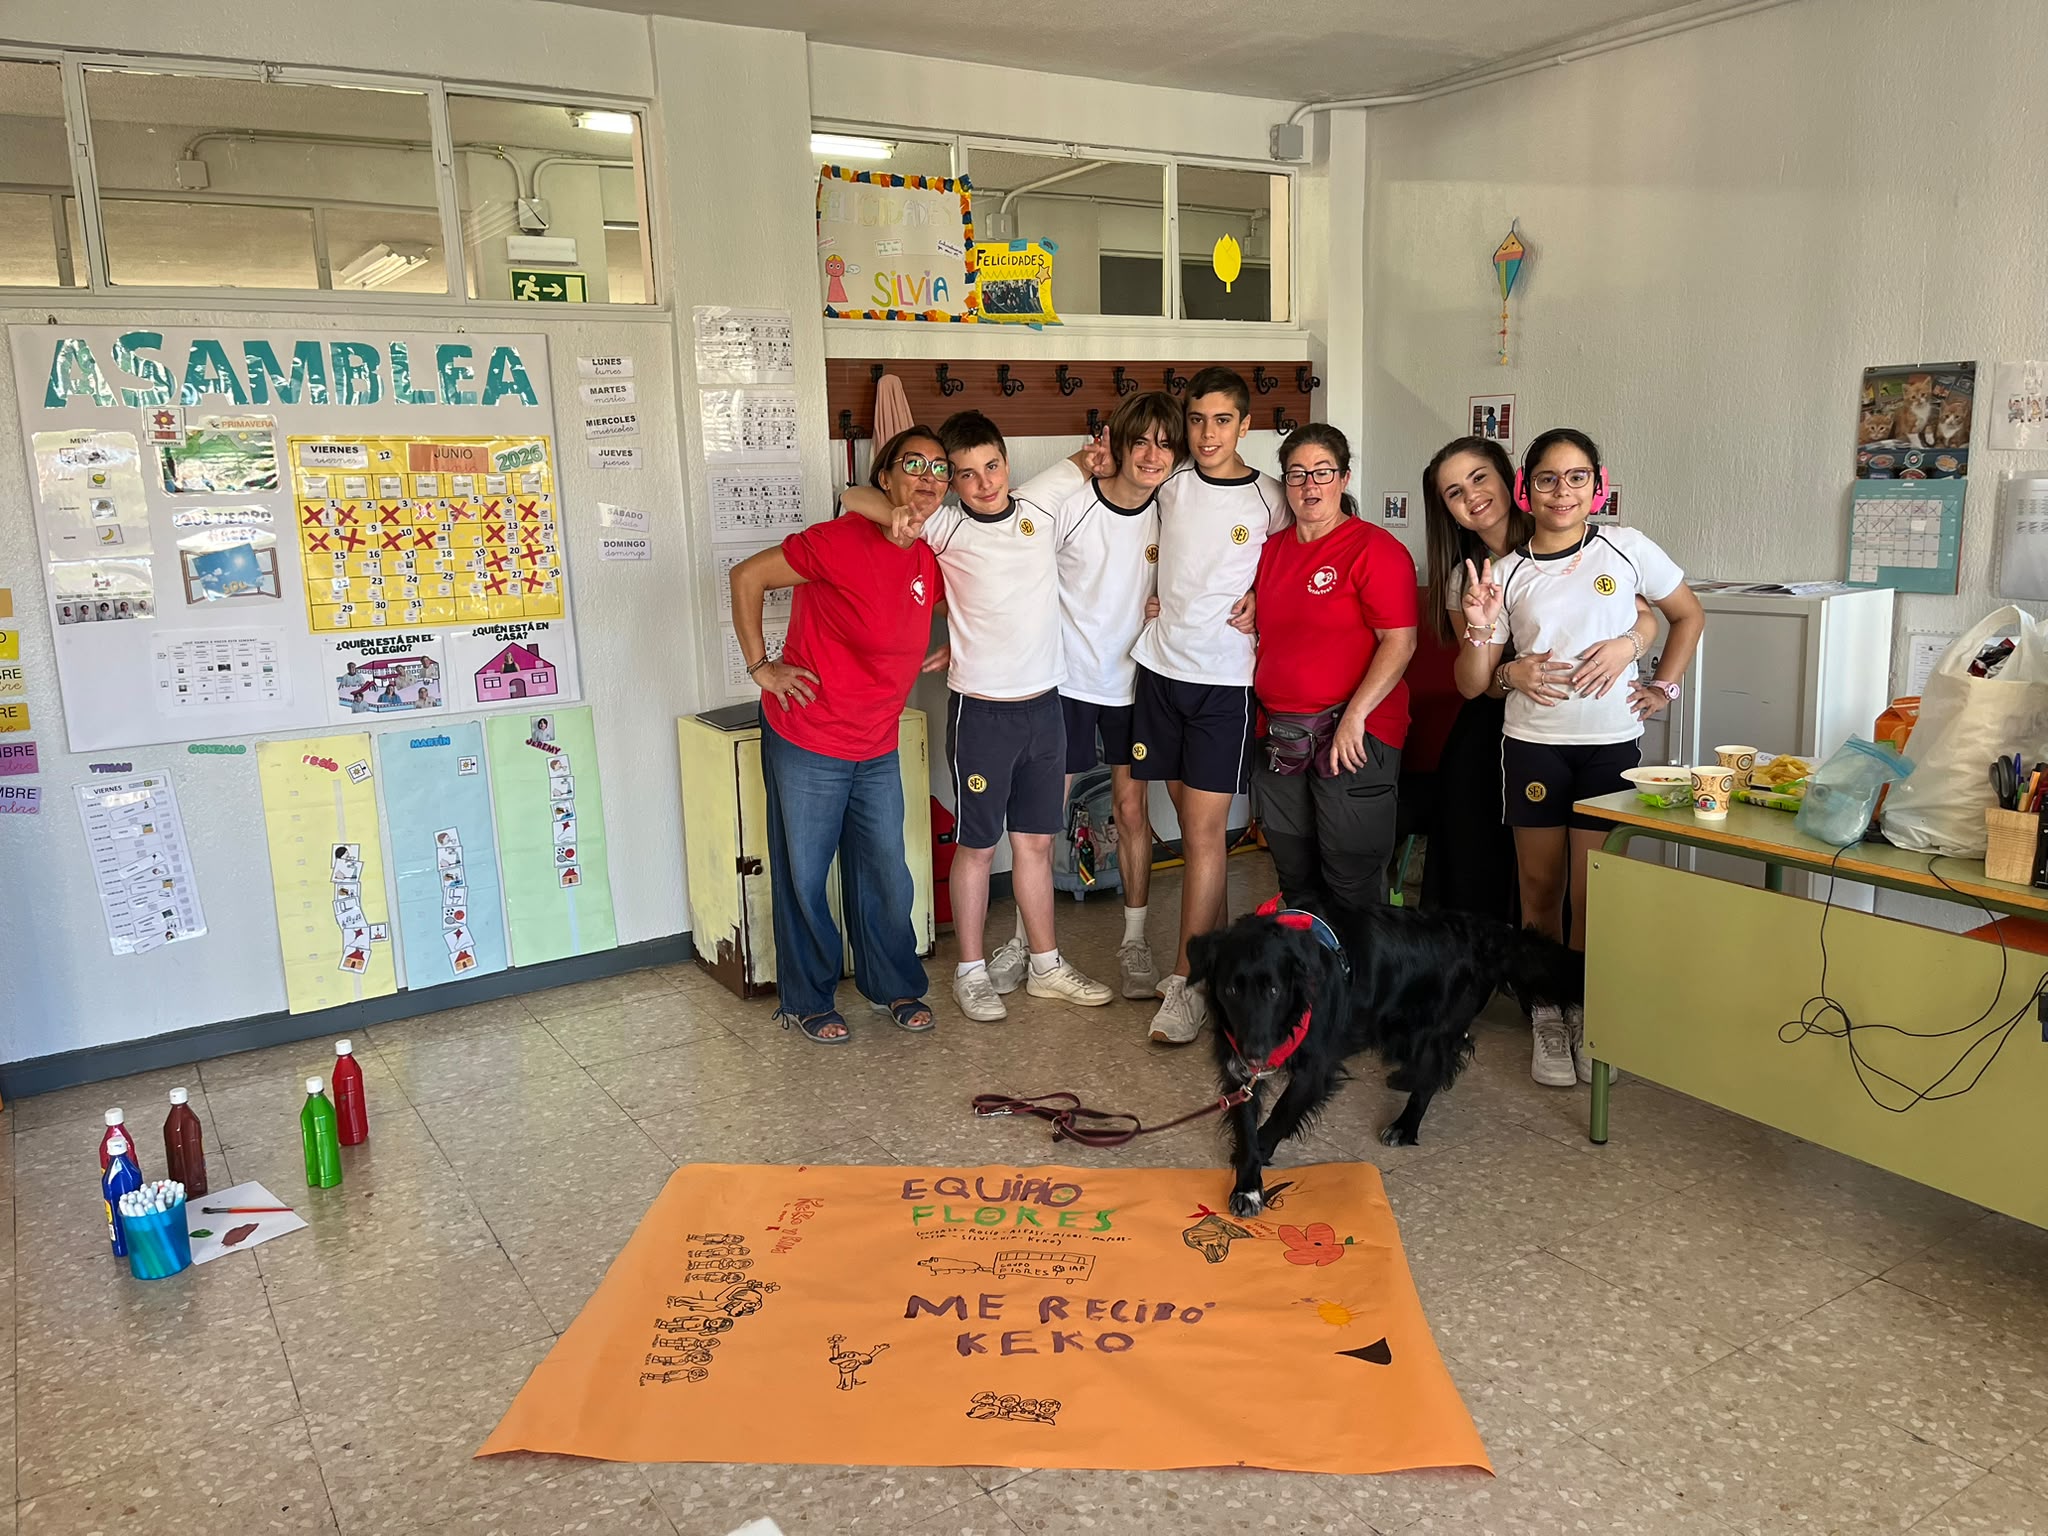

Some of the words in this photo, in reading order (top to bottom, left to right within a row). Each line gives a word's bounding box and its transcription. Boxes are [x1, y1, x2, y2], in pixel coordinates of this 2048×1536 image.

[976, 249, 1045, 267] FELICIDADES
[871, 270, 949, 308] SILVIA
[592, 358, 622, 366] LUNES
[44, 330, 538, 408] ASAMBLEA
[595, 367, 622, 375] lunes
[590, 385, 627, 395] MARTES
[221, 420, 273, 428] PRIMAVERA
[586, 415, 636, 427] MIERCOLES
[310, 446, 359, 454] VIERNES
[380, 451, 391, 460] 12
[434, 448, 473, 459] JUNIO
[495, 444, 544, 472] 2026
[602, 458, 630, 469] jueves
[366, 501, 373, 509] 2
[473, 496, 479, 504] 5
[507, 496, 513, 504] 6
[334, 528, 340, 536] 8
[371, 524, 377, 532] 9
[401, 528, 412, 537] 10
[544, 523, 554, 531] 14
[369, 550, 380, 558] 16
[405, 550, 416, 559] 17
[441, 550, 452, 558] 18
[475, 548, 486, 558] 19
[546, 545, 555, 553] 21
[605, 549, 646, 559] domingo
[371, 577, 383, 585] 23
[406, 575, 418, 584] 24
[443, 573, 454, 581] 25
[512, 571, 523, 579] 27
[549, 569, 560, 578] 28
[222, 581, 248, 595] SOL
[342, 604, 353, 612] 29
[375, 601, 386, 609] 30
[411, 600, 422, 609] 31
[472, 625, 508, 636] ¿QUIÉN
[508, 622, 535, 633] ESTÁ
[536, 622, 549, 630] EN
[336, 638, 374, 650] ¿QUIÉN
[376, 635, 404, 646] ESTÁ
[406, 635, 420, 643] EN
[496, 631, 528, 642] CASA?
[361, 644, 412, 656] COLEGIO?
[410, 734, 451, 748] MARTÍN
[525, 738, 561, 755] JEREMY
[188, 744, 247, 754] GONZALO
[93, 785, 122, 794] VIERNES
[912, 1205, 1117, 1232] FLORES
[904, 1293, 1007, 1321] ME
[956, 1331, 1135, 1357] KEKO
